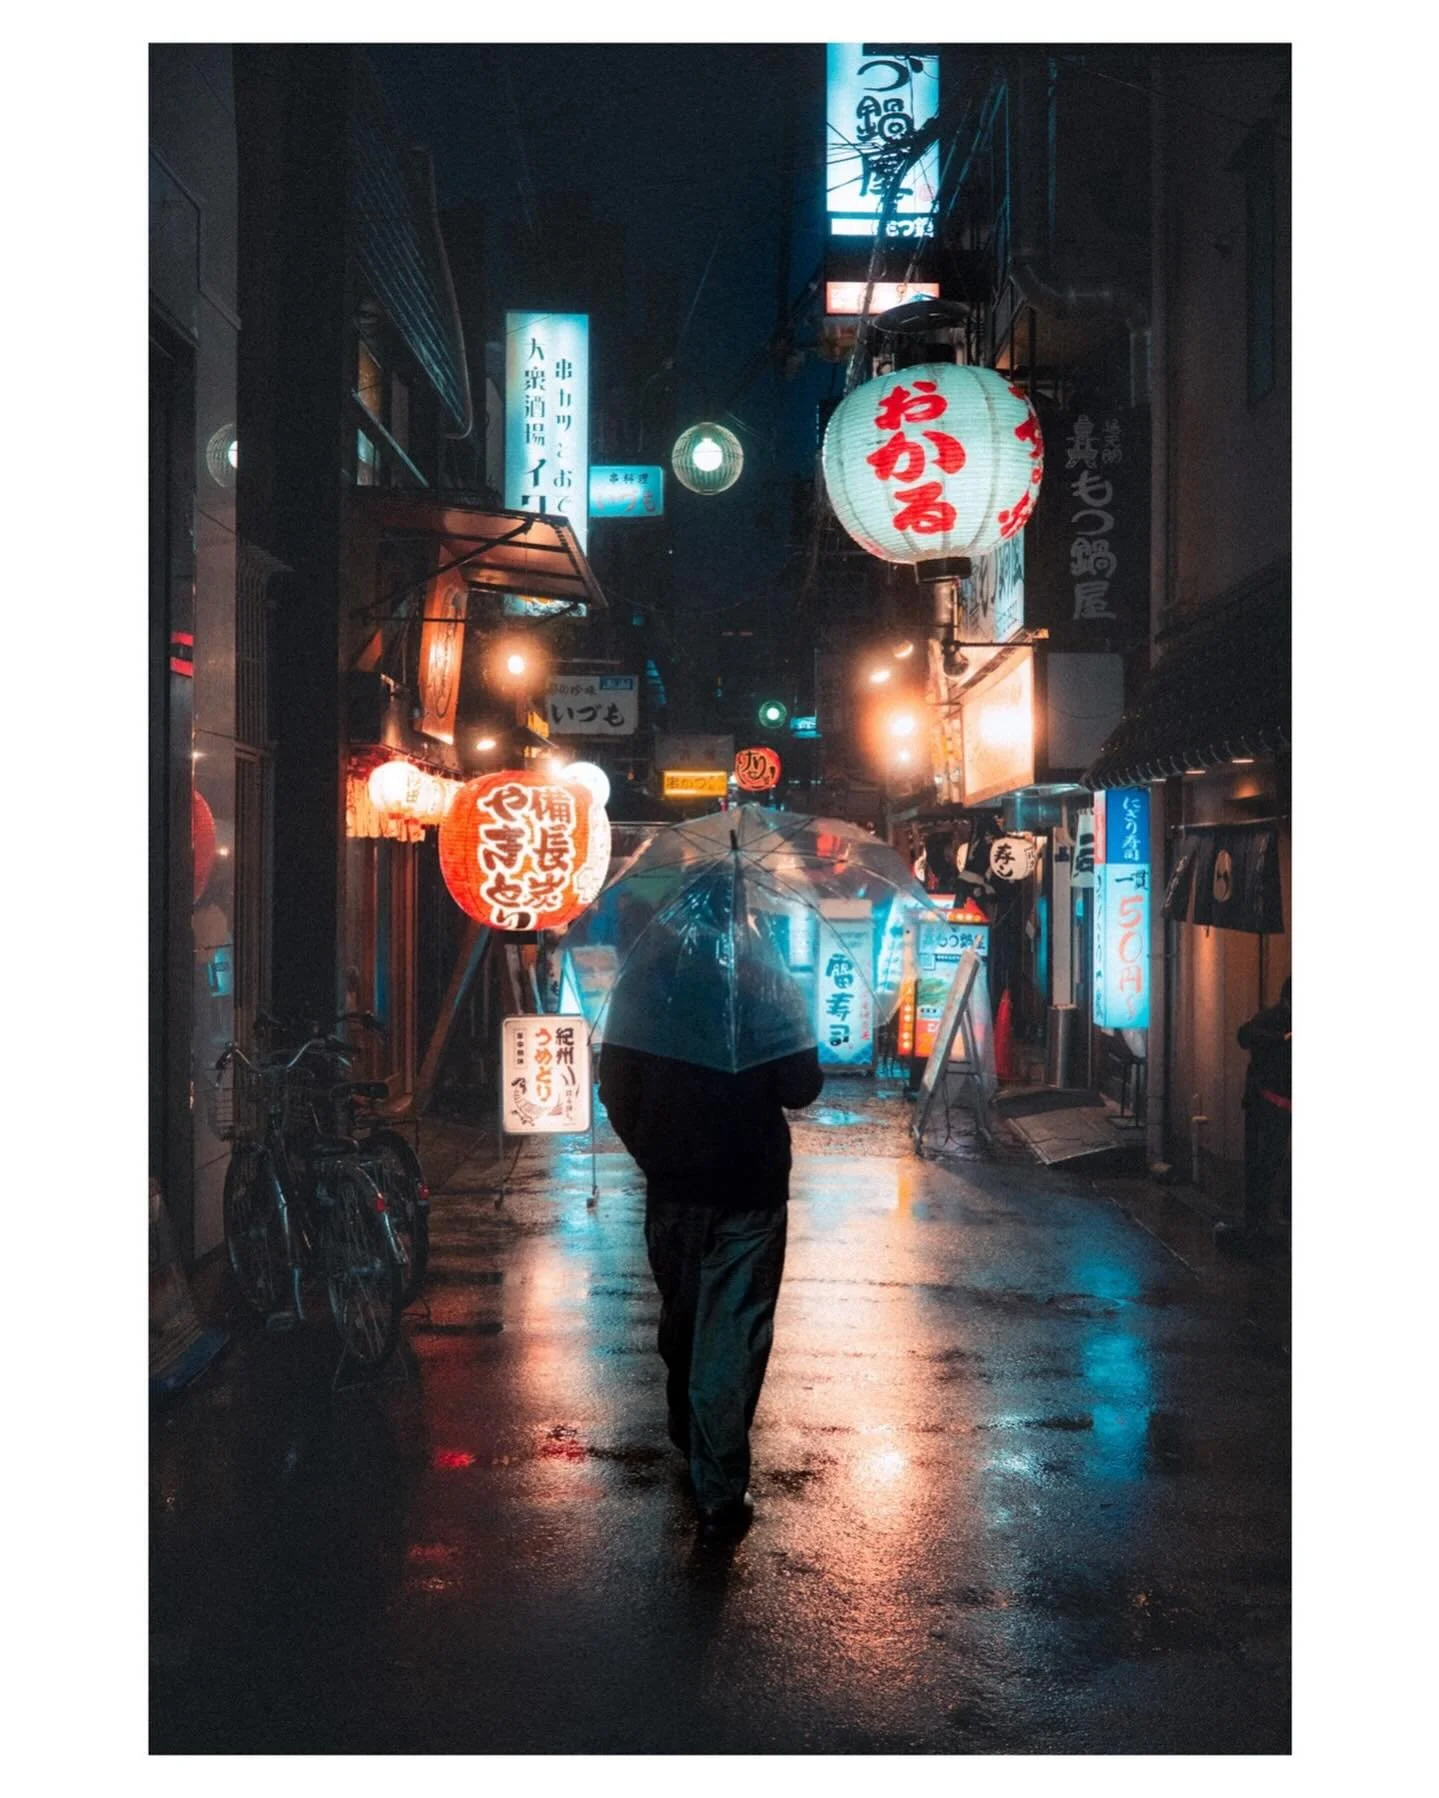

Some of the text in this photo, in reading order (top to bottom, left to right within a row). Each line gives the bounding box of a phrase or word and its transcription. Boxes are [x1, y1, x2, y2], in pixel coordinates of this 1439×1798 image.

[867, 381, 966, 535] おかる
[551, 702, 625, 727] いづも
[480, 784, 533, 930] やきとり
[524, 786, 574, 909] 備長炭
[994, 843, 1016, 877] 寿し
[825, 953, 856, 1047] 雷寿司
